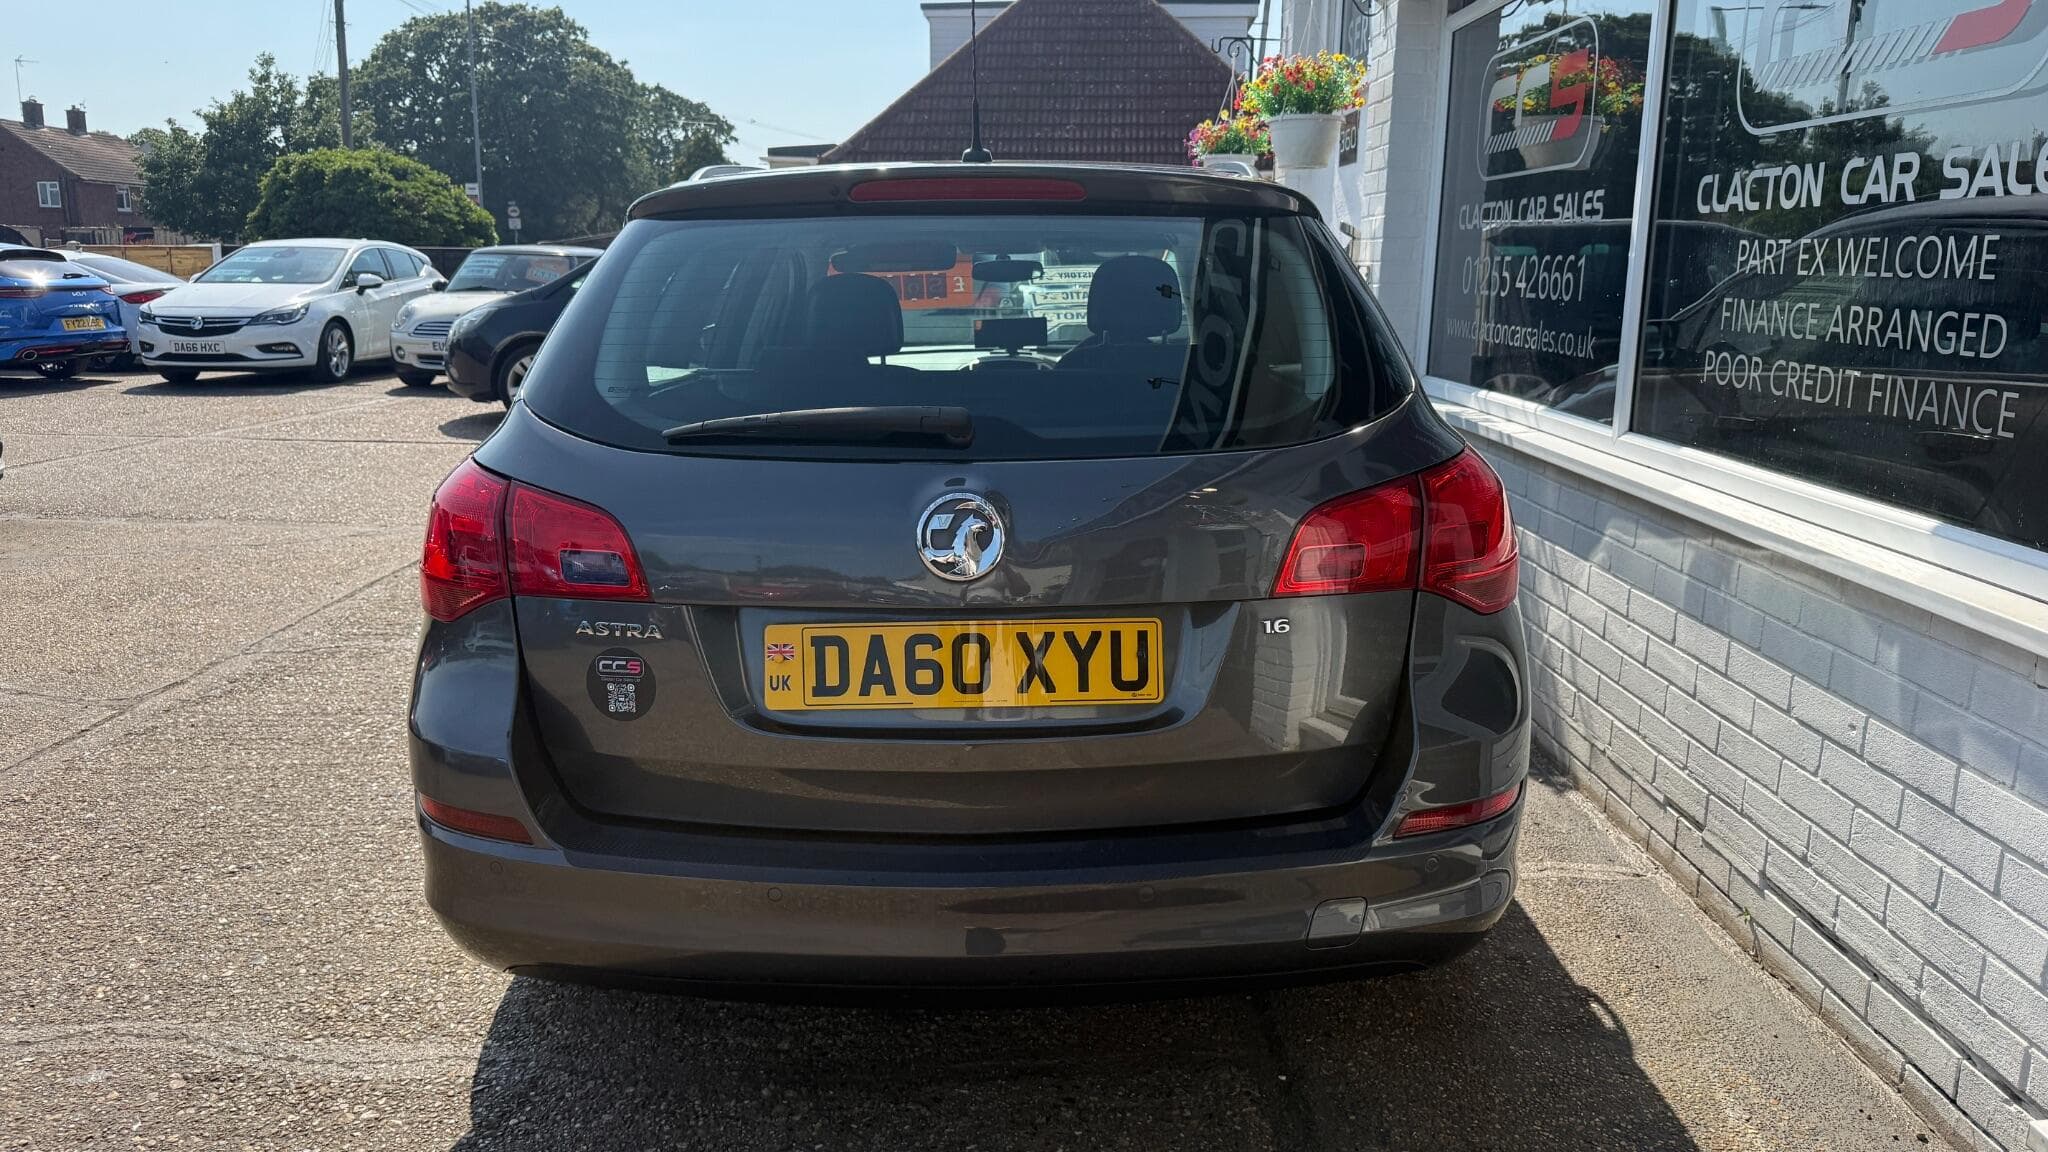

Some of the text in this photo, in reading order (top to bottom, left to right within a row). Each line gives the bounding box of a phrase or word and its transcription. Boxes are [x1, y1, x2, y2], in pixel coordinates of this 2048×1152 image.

[1697, 139, 2048, 214] CLACTON CAR SAL
[1459, 189, 1605, 230] CLACTON CAR SALES
[1462, 254, 1586, 302] 01255 426661
[1736, 234, 2000, 280] PART EX WELCOME
[174, 342, 220, 352] DA66 HXC
[1447, 318, 1597, 360] www.clactoncarsales.co.uk
[1720, 297, 2008, 359] FINANCE ARRANGED
[1703, 350, 2020, 439] POOR CREDIT FINANCE
[576, 620, 664, 639] ASTRA
[1263, 618, 1290, 634] 1.6
[599, 661, 640, 673] CCS
[769, 675, 791, 691] UK
[811, 630, 1149, 697] DA60 XYU
